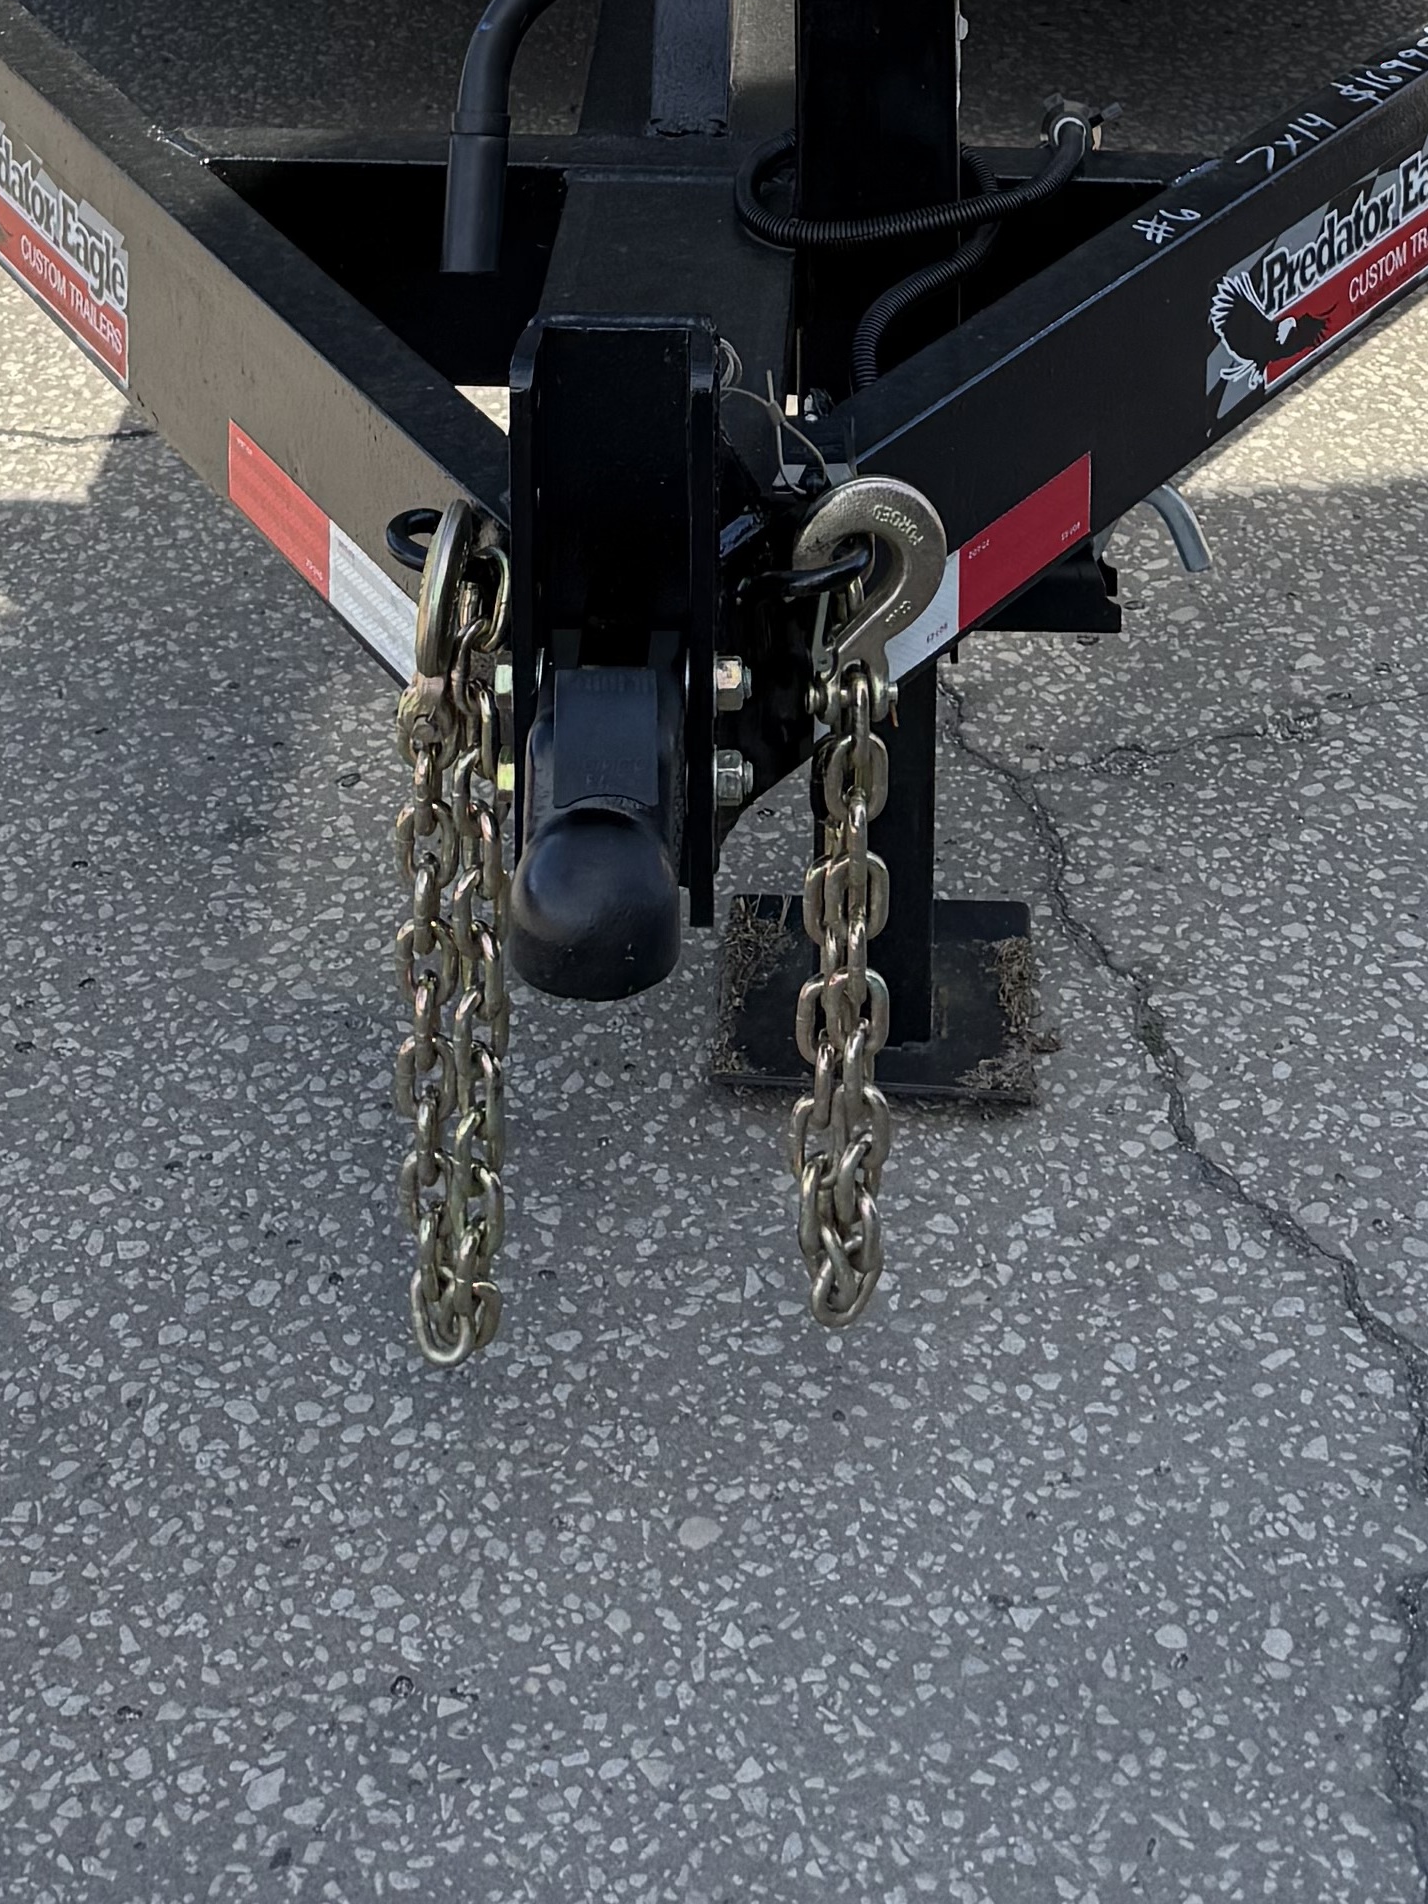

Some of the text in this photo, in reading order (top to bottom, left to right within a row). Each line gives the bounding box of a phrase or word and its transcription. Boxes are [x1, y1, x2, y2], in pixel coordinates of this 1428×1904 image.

[20, 234, 124, 356] CUSTOM TRAILERS
[58, 189, 128, 309] Eagle
[1262, 184, 1397, 319] Predator
[1348, 240, 1408, 304] CUSTOM
